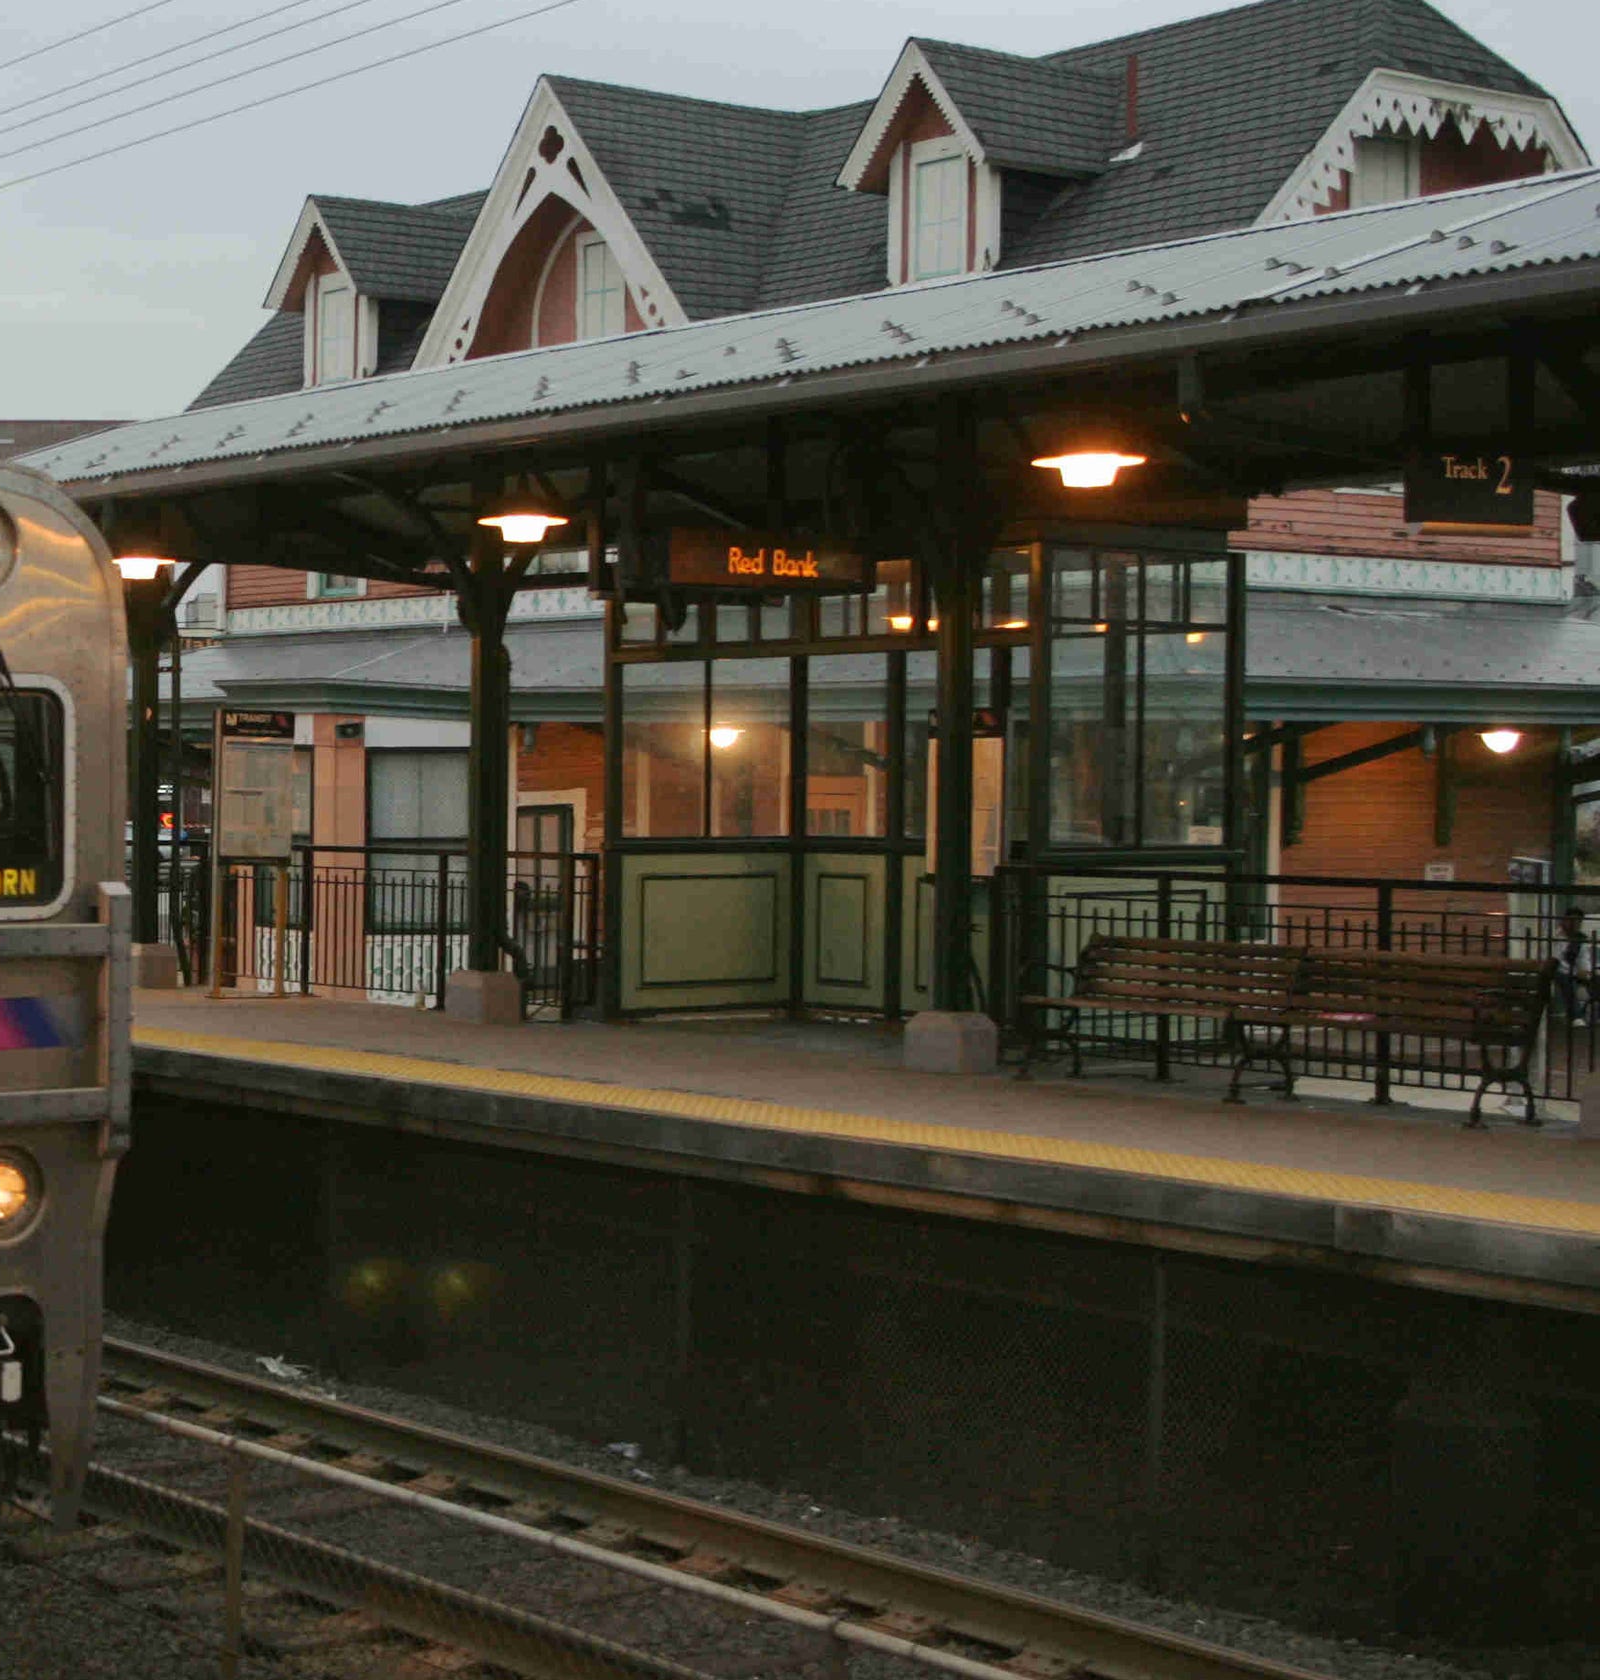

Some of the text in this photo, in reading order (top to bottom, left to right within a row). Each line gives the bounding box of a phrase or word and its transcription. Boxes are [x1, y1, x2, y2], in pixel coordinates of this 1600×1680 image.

[1441, 456, 1512, 494] Track 2
[728, 547, 819, 578] Red Bank
